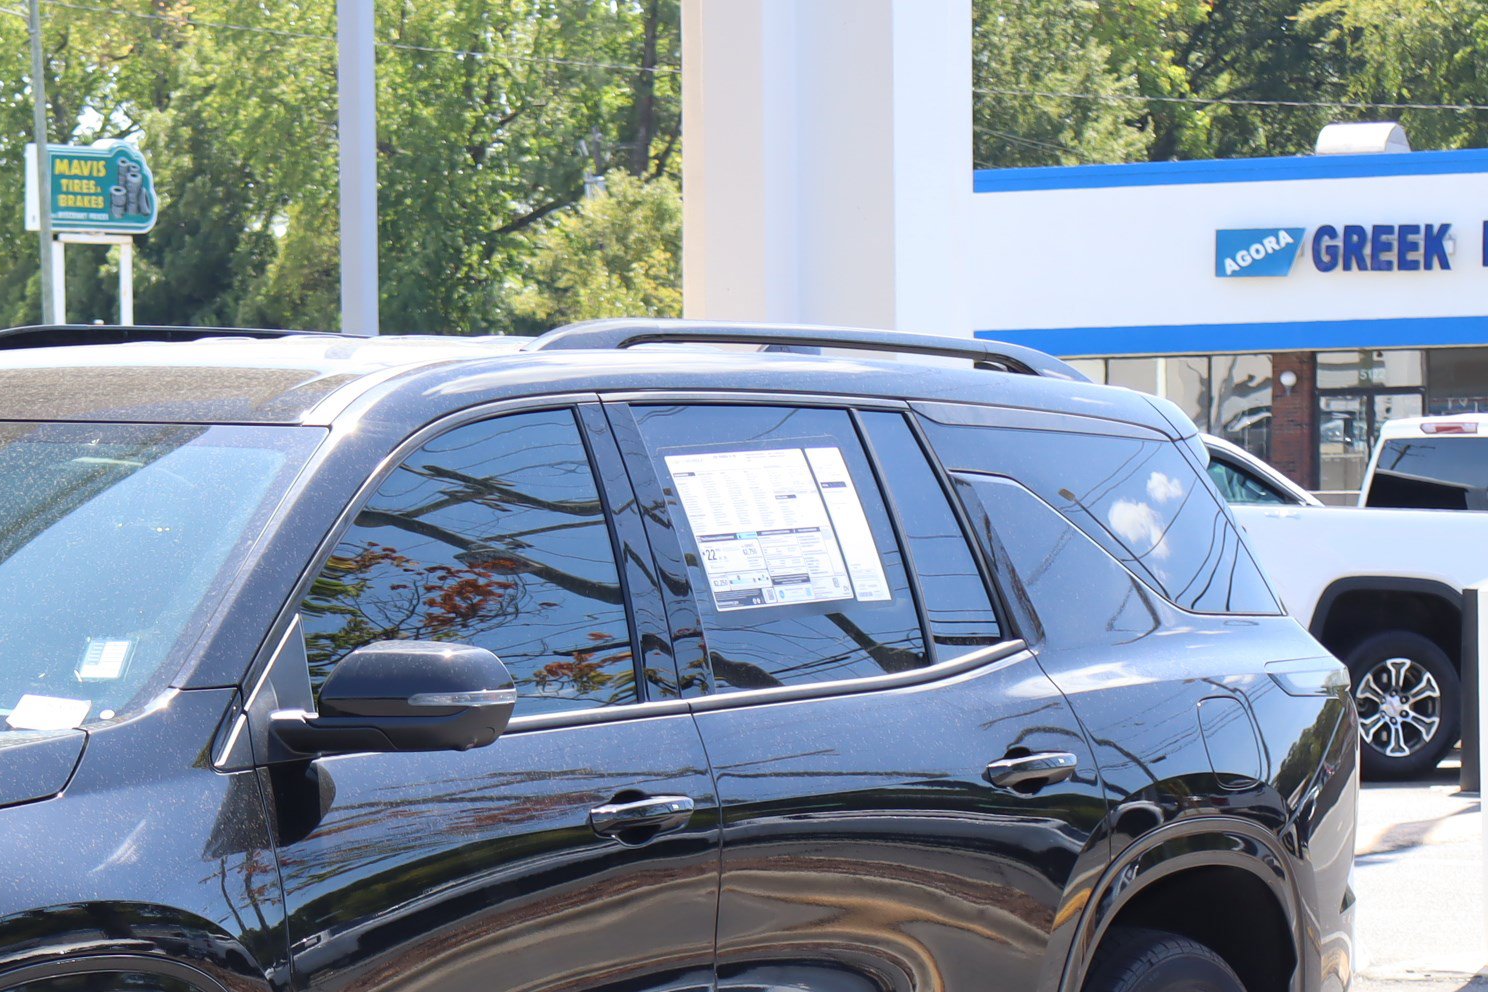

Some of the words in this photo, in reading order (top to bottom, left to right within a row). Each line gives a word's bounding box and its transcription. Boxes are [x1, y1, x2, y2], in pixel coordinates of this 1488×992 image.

[55, 158, 107, 177] MAVIS
[60, 179, 96, 193] TIRES
[57, 194, 104, 208] BRAKES
[1223, 229, 1294, 275] AGORA
[1312, 223, 1452, 273] GREEK
[705, 549, 718, 561] 22
